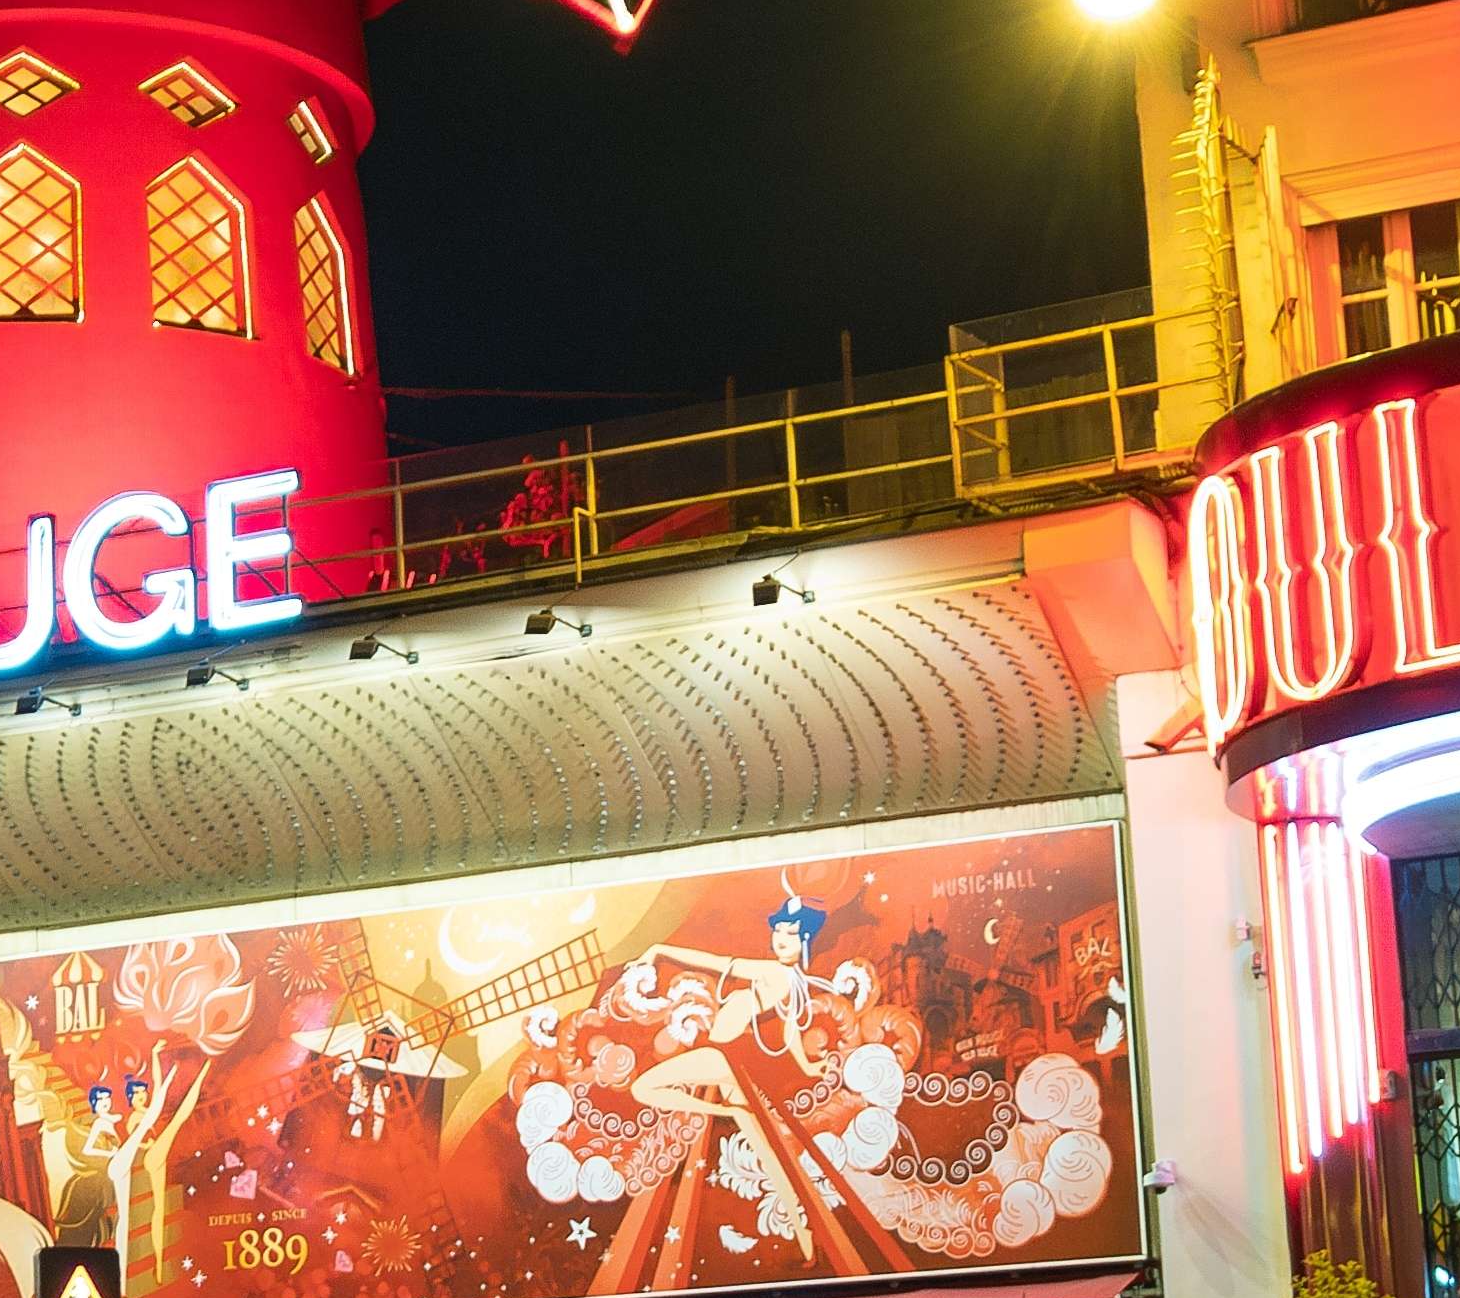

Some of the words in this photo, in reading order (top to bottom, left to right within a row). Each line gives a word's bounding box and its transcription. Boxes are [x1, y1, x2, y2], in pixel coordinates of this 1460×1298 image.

[1073, 936, 1113, 967] BAL
[54, 981, 106, 1035] BAL
[208, 1212, 253, 1227] DEPUIS
[271, 1208, 308, 1222] SINCE
[223, 1227, 310, 1275] 1889
